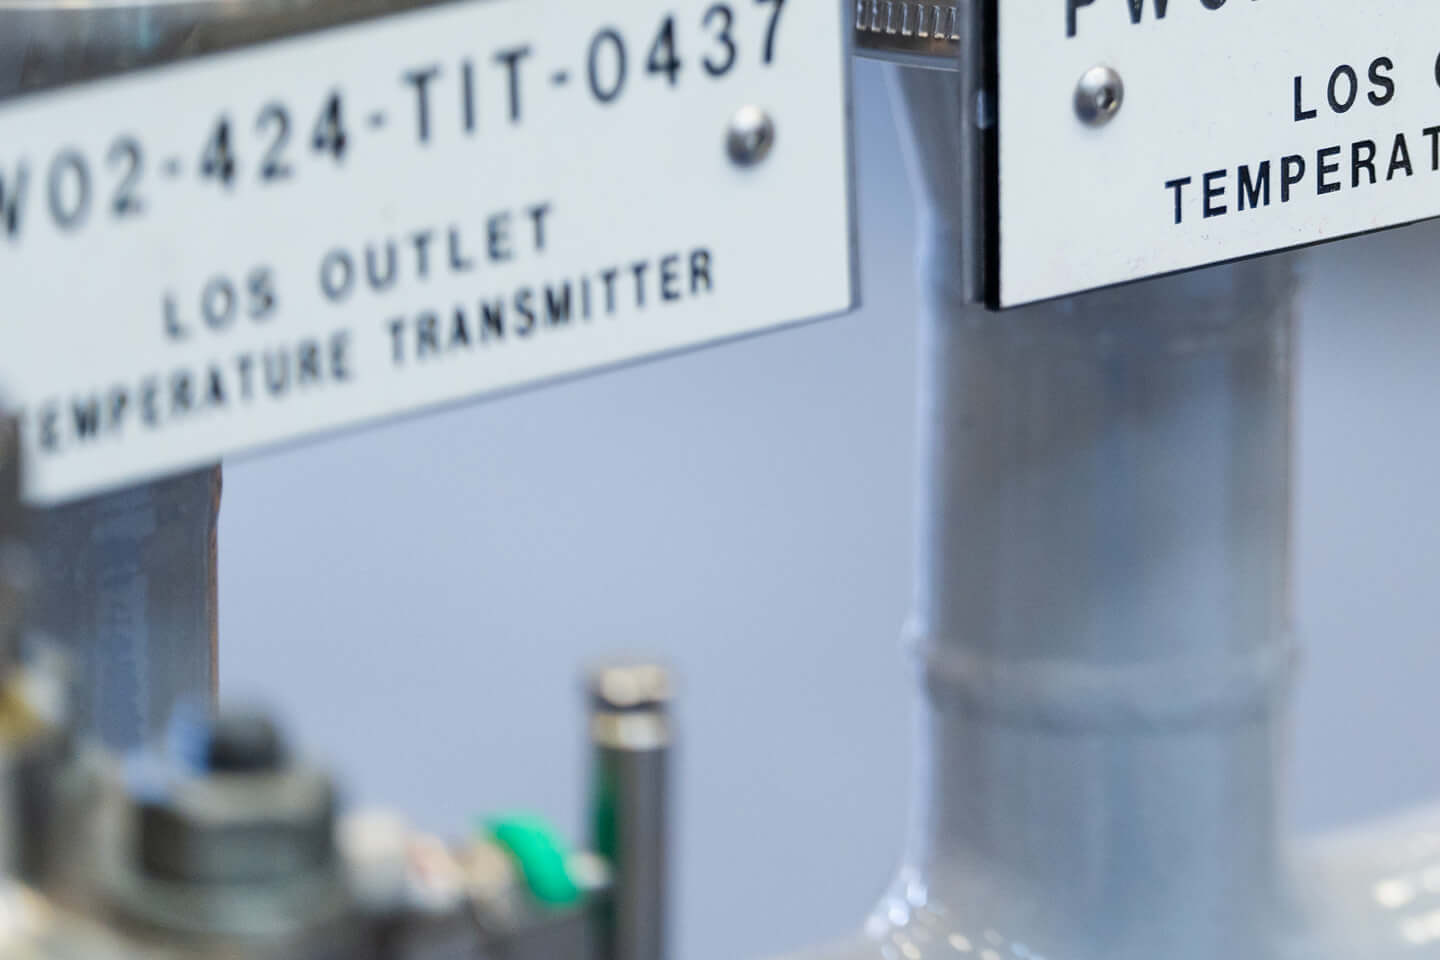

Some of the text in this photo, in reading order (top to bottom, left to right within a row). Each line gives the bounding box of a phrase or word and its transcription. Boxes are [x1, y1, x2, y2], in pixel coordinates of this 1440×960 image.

[1292, 55, 1396, 123] LOS
[161, 201, 552, 342] LOS OUTLET
[20, 246, 715, 455] EMPERATURE TRANSMITTER
